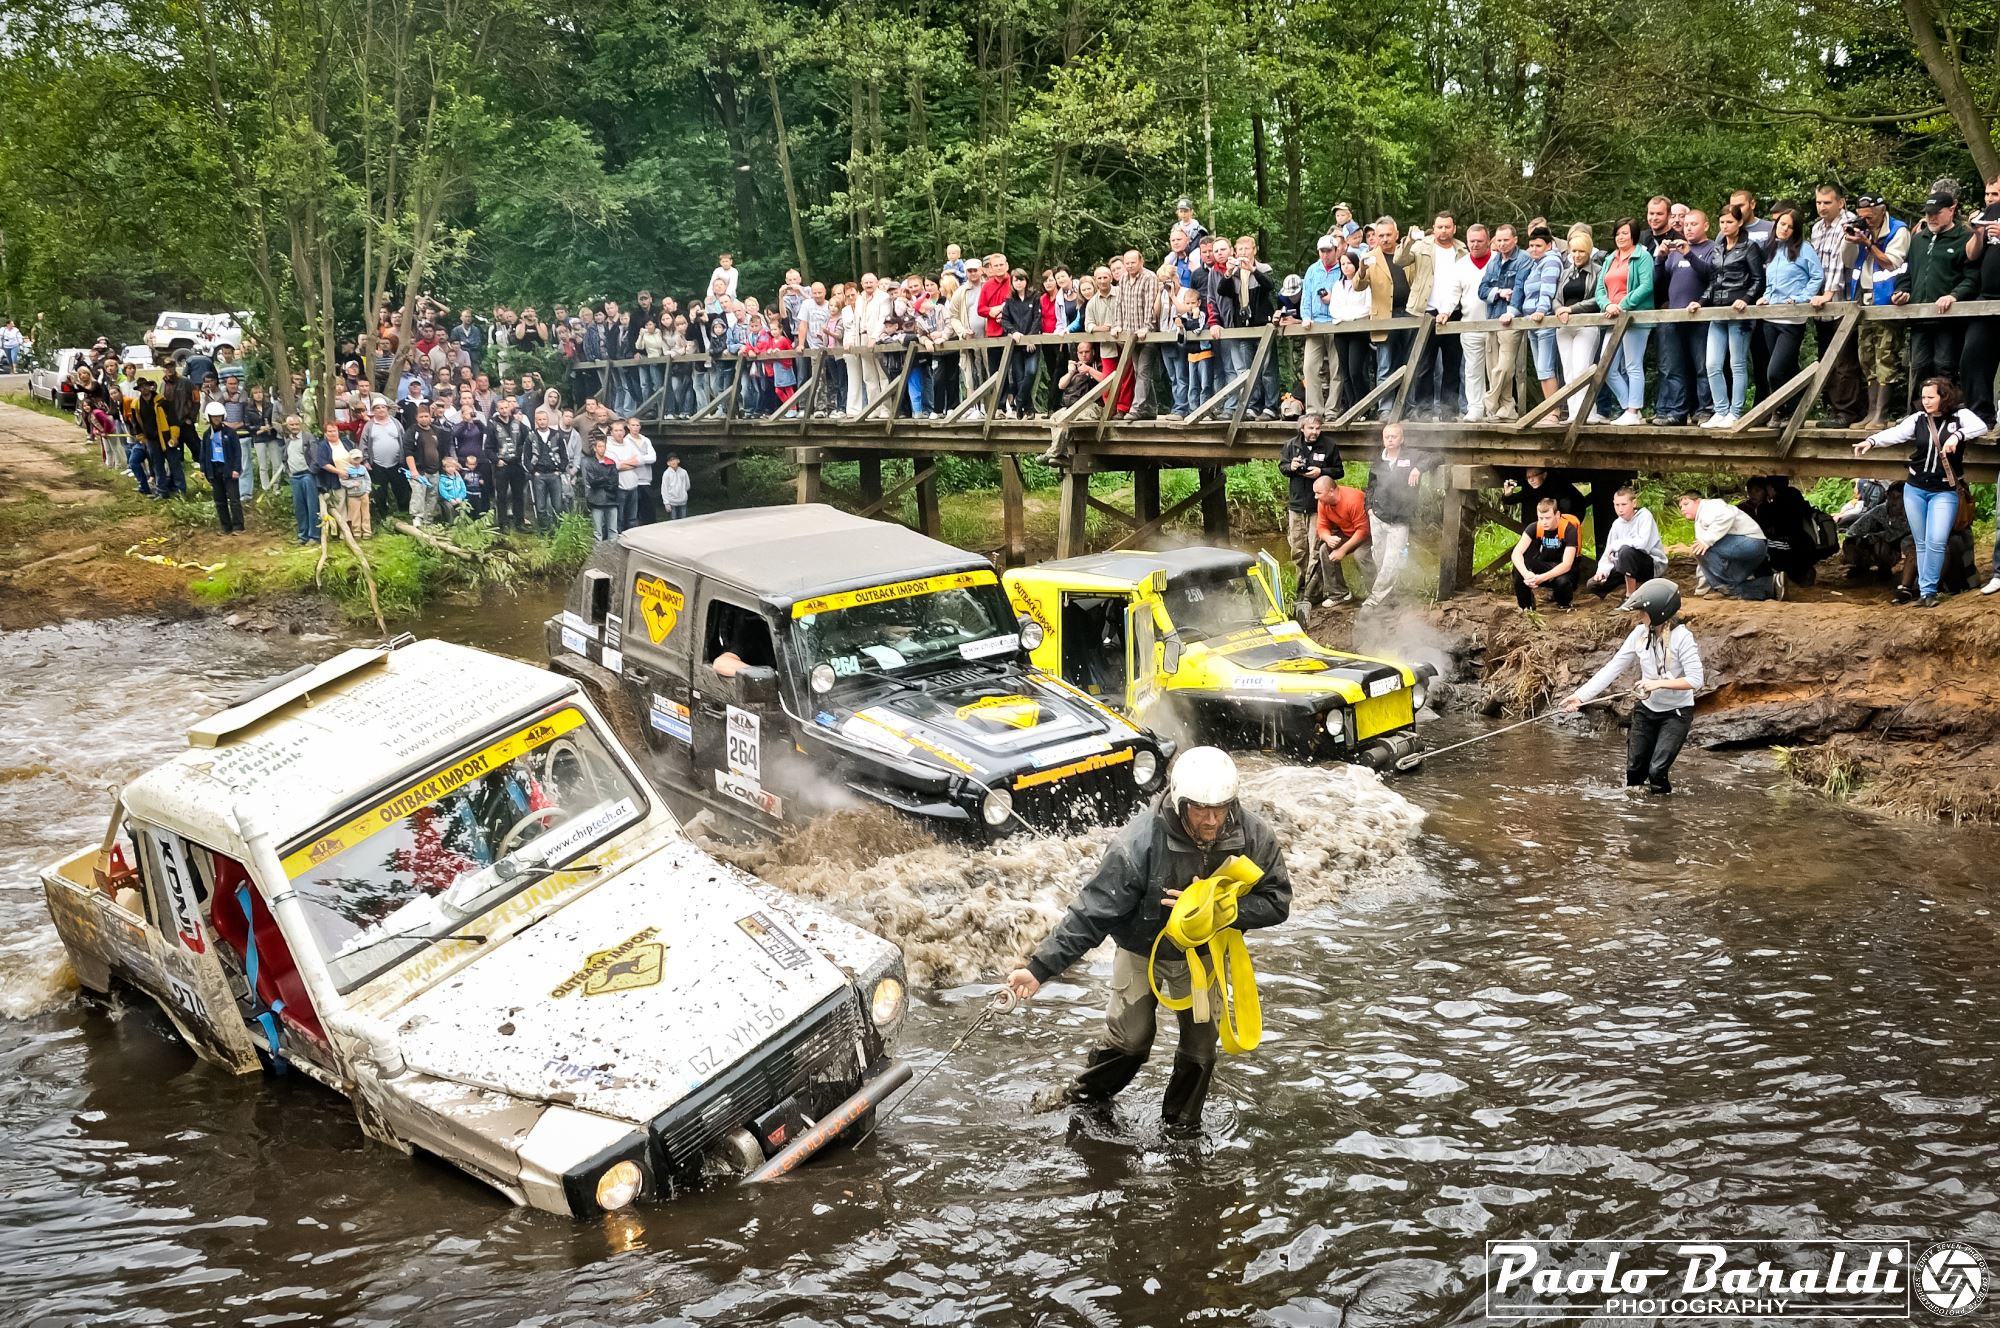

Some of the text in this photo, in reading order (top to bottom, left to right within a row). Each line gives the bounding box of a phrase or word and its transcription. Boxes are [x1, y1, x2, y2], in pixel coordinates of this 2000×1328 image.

[638, 582, 683, 608] OUTBACK IMPORT
[855, 581, 930, 603] OUTBACK IMPORT
[1014, 582, 1056, 637] OUTBACK IMPORT
[1184, 588, 1205, 603] 250
[832, 656, 861, 677] 264
[530, 726, 542, 740] 17
[729, 735, 758, 771] 264
[379, 753, 490, 823] OUTBACK IMPORT
[545, 804, 628, 858] www.chiptech.at
[158, 838, 195, 936] KONI
[551, 926, 660, 1000] OUTBACK IMPORT
[688, 1004, 786, 1075] GZ YM 56
